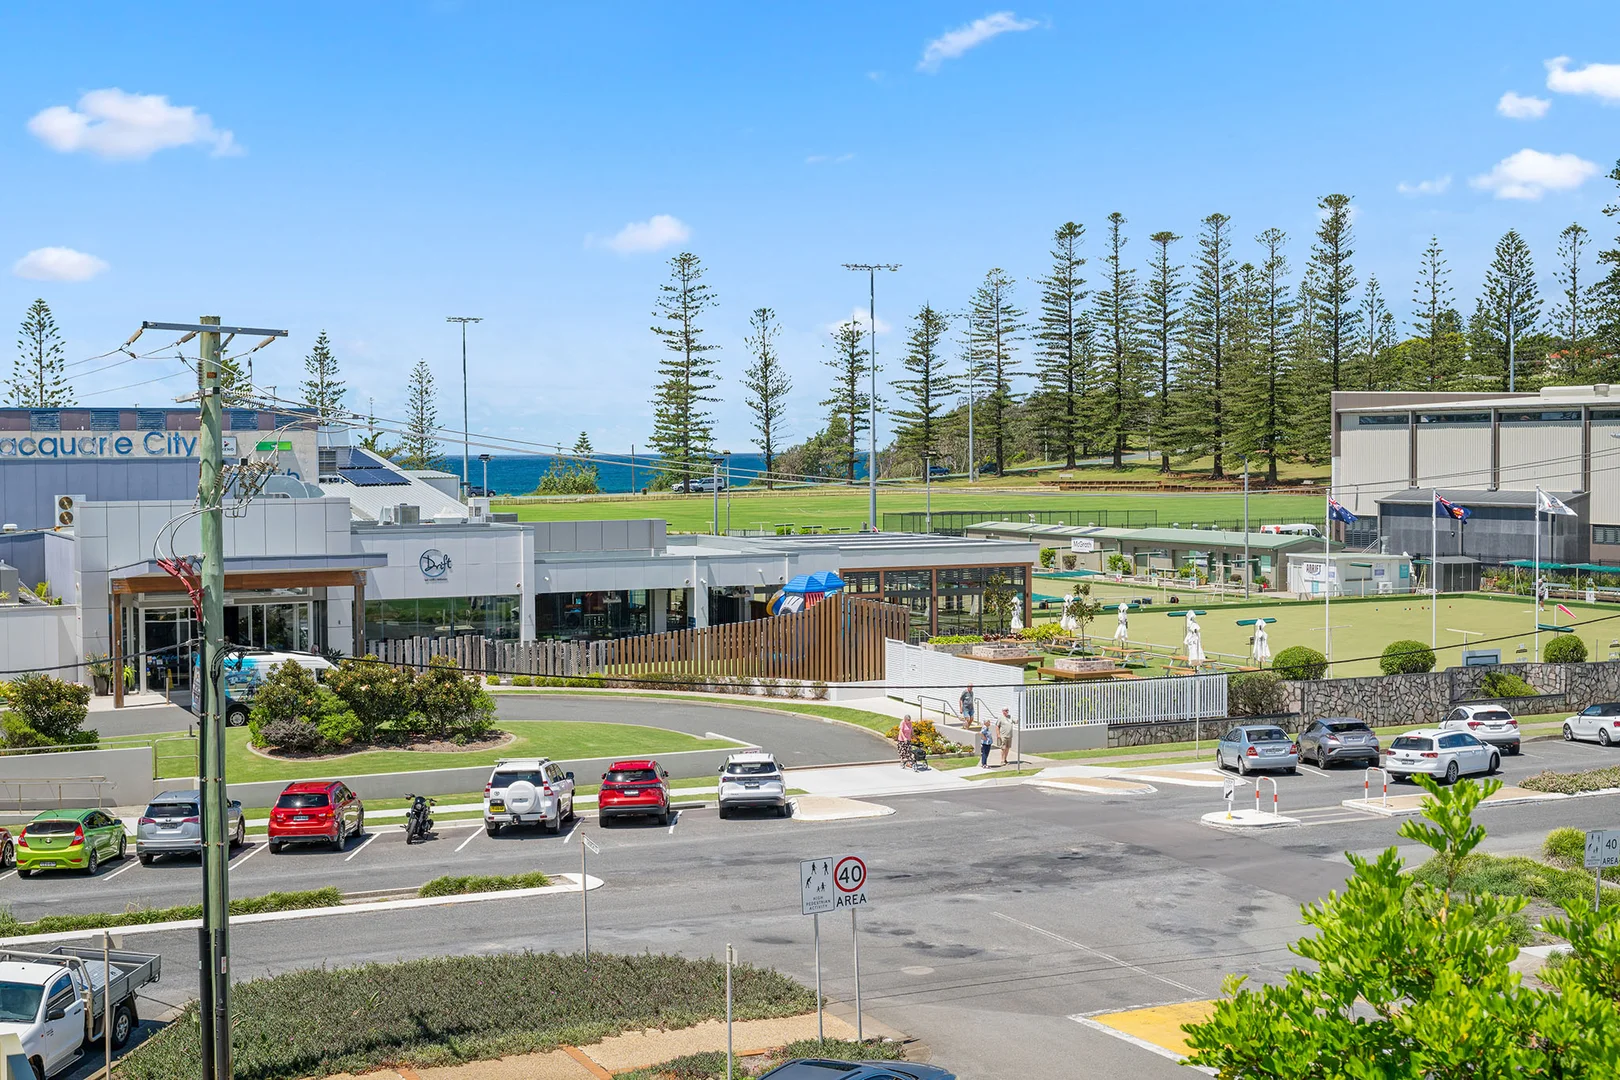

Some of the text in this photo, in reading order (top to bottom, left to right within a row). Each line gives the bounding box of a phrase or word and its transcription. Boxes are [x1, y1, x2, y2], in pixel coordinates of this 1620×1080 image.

[143, 431, 197, 457] City
[422, 553, 452, 572] Drift
[1605, 838, 1618, 850] 40
[1602, 856, 1619, 865] AREA
[838, 865, 862, 884] 40
[836, 893, 867, 908] AREA
